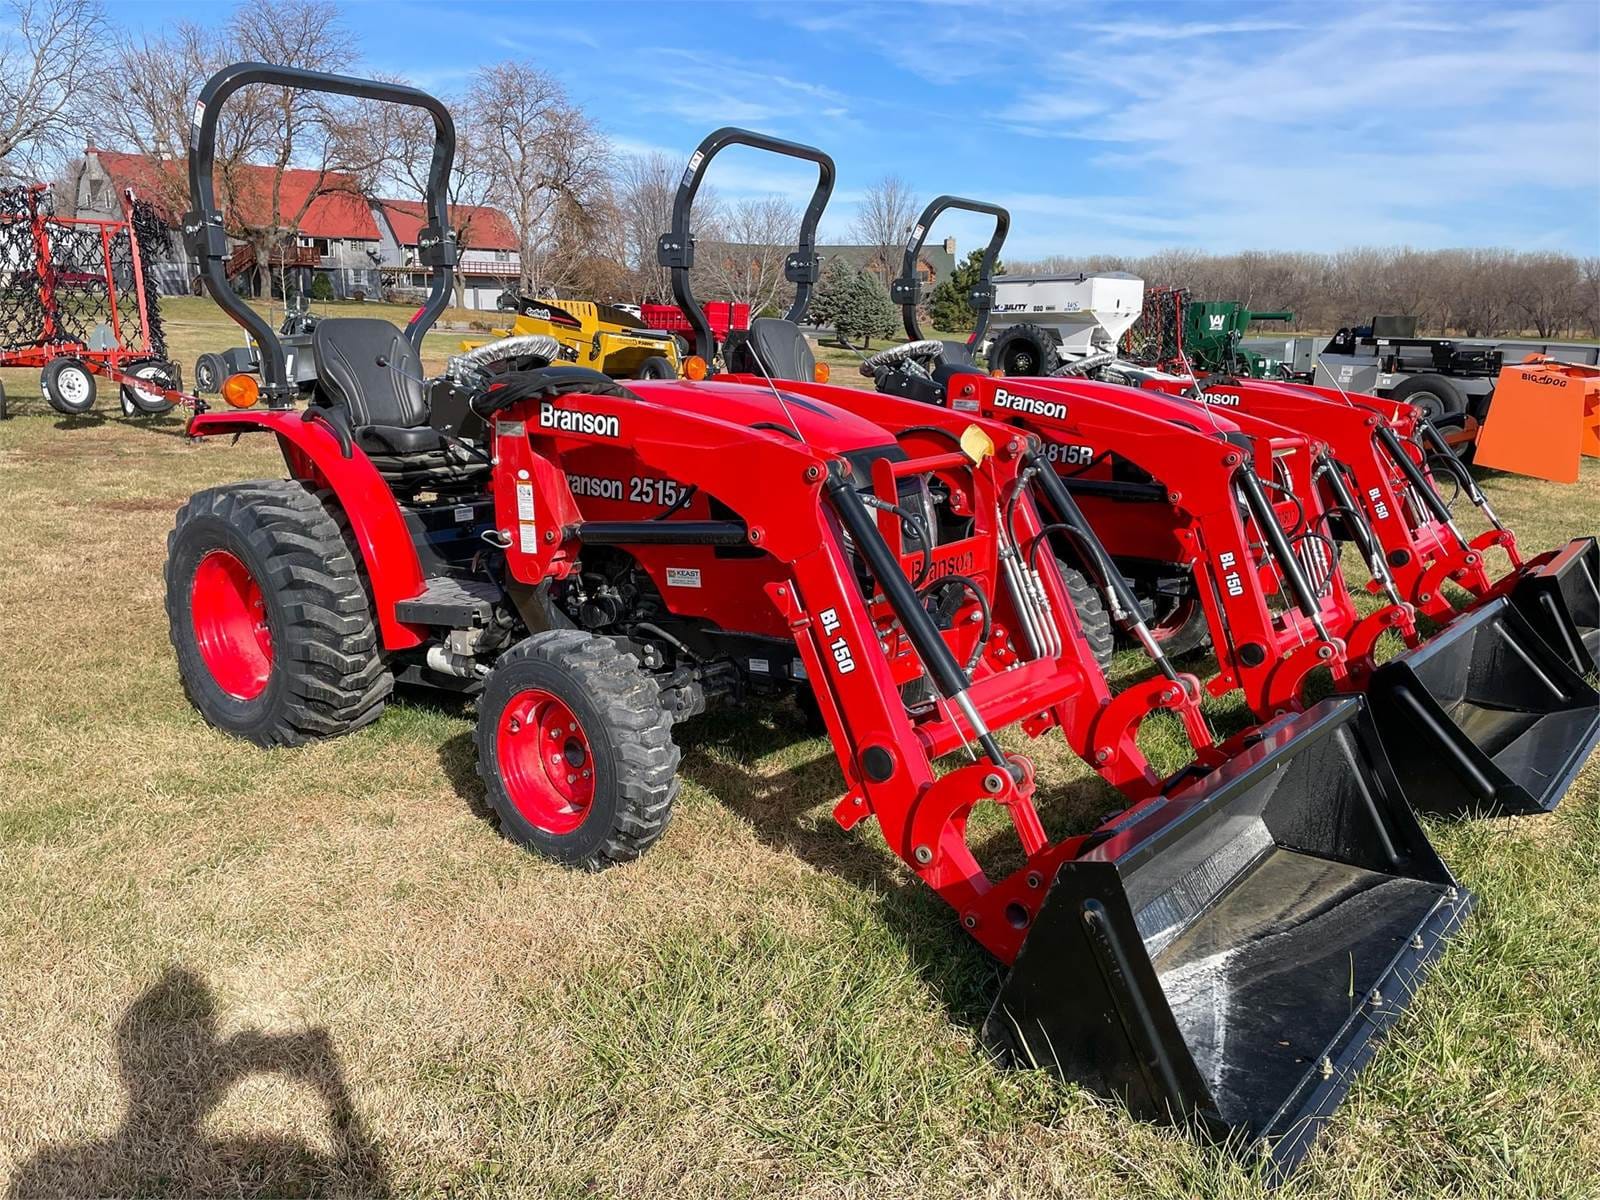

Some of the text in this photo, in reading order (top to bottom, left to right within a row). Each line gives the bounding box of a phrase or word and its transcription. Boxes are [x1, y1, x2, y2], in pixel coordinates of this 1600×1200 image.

[1521, 373, 1538, 382] BIG
[540, 402, 619, 437] Branson
[993, 388, 1067, 419] Branson
[566, 474, 623, 500] ranson
[1368, 487, 1390, 520] BL 150
[1220, 552, 1244, 597] BL 150
[819, 608, 856, 674] BL 150
